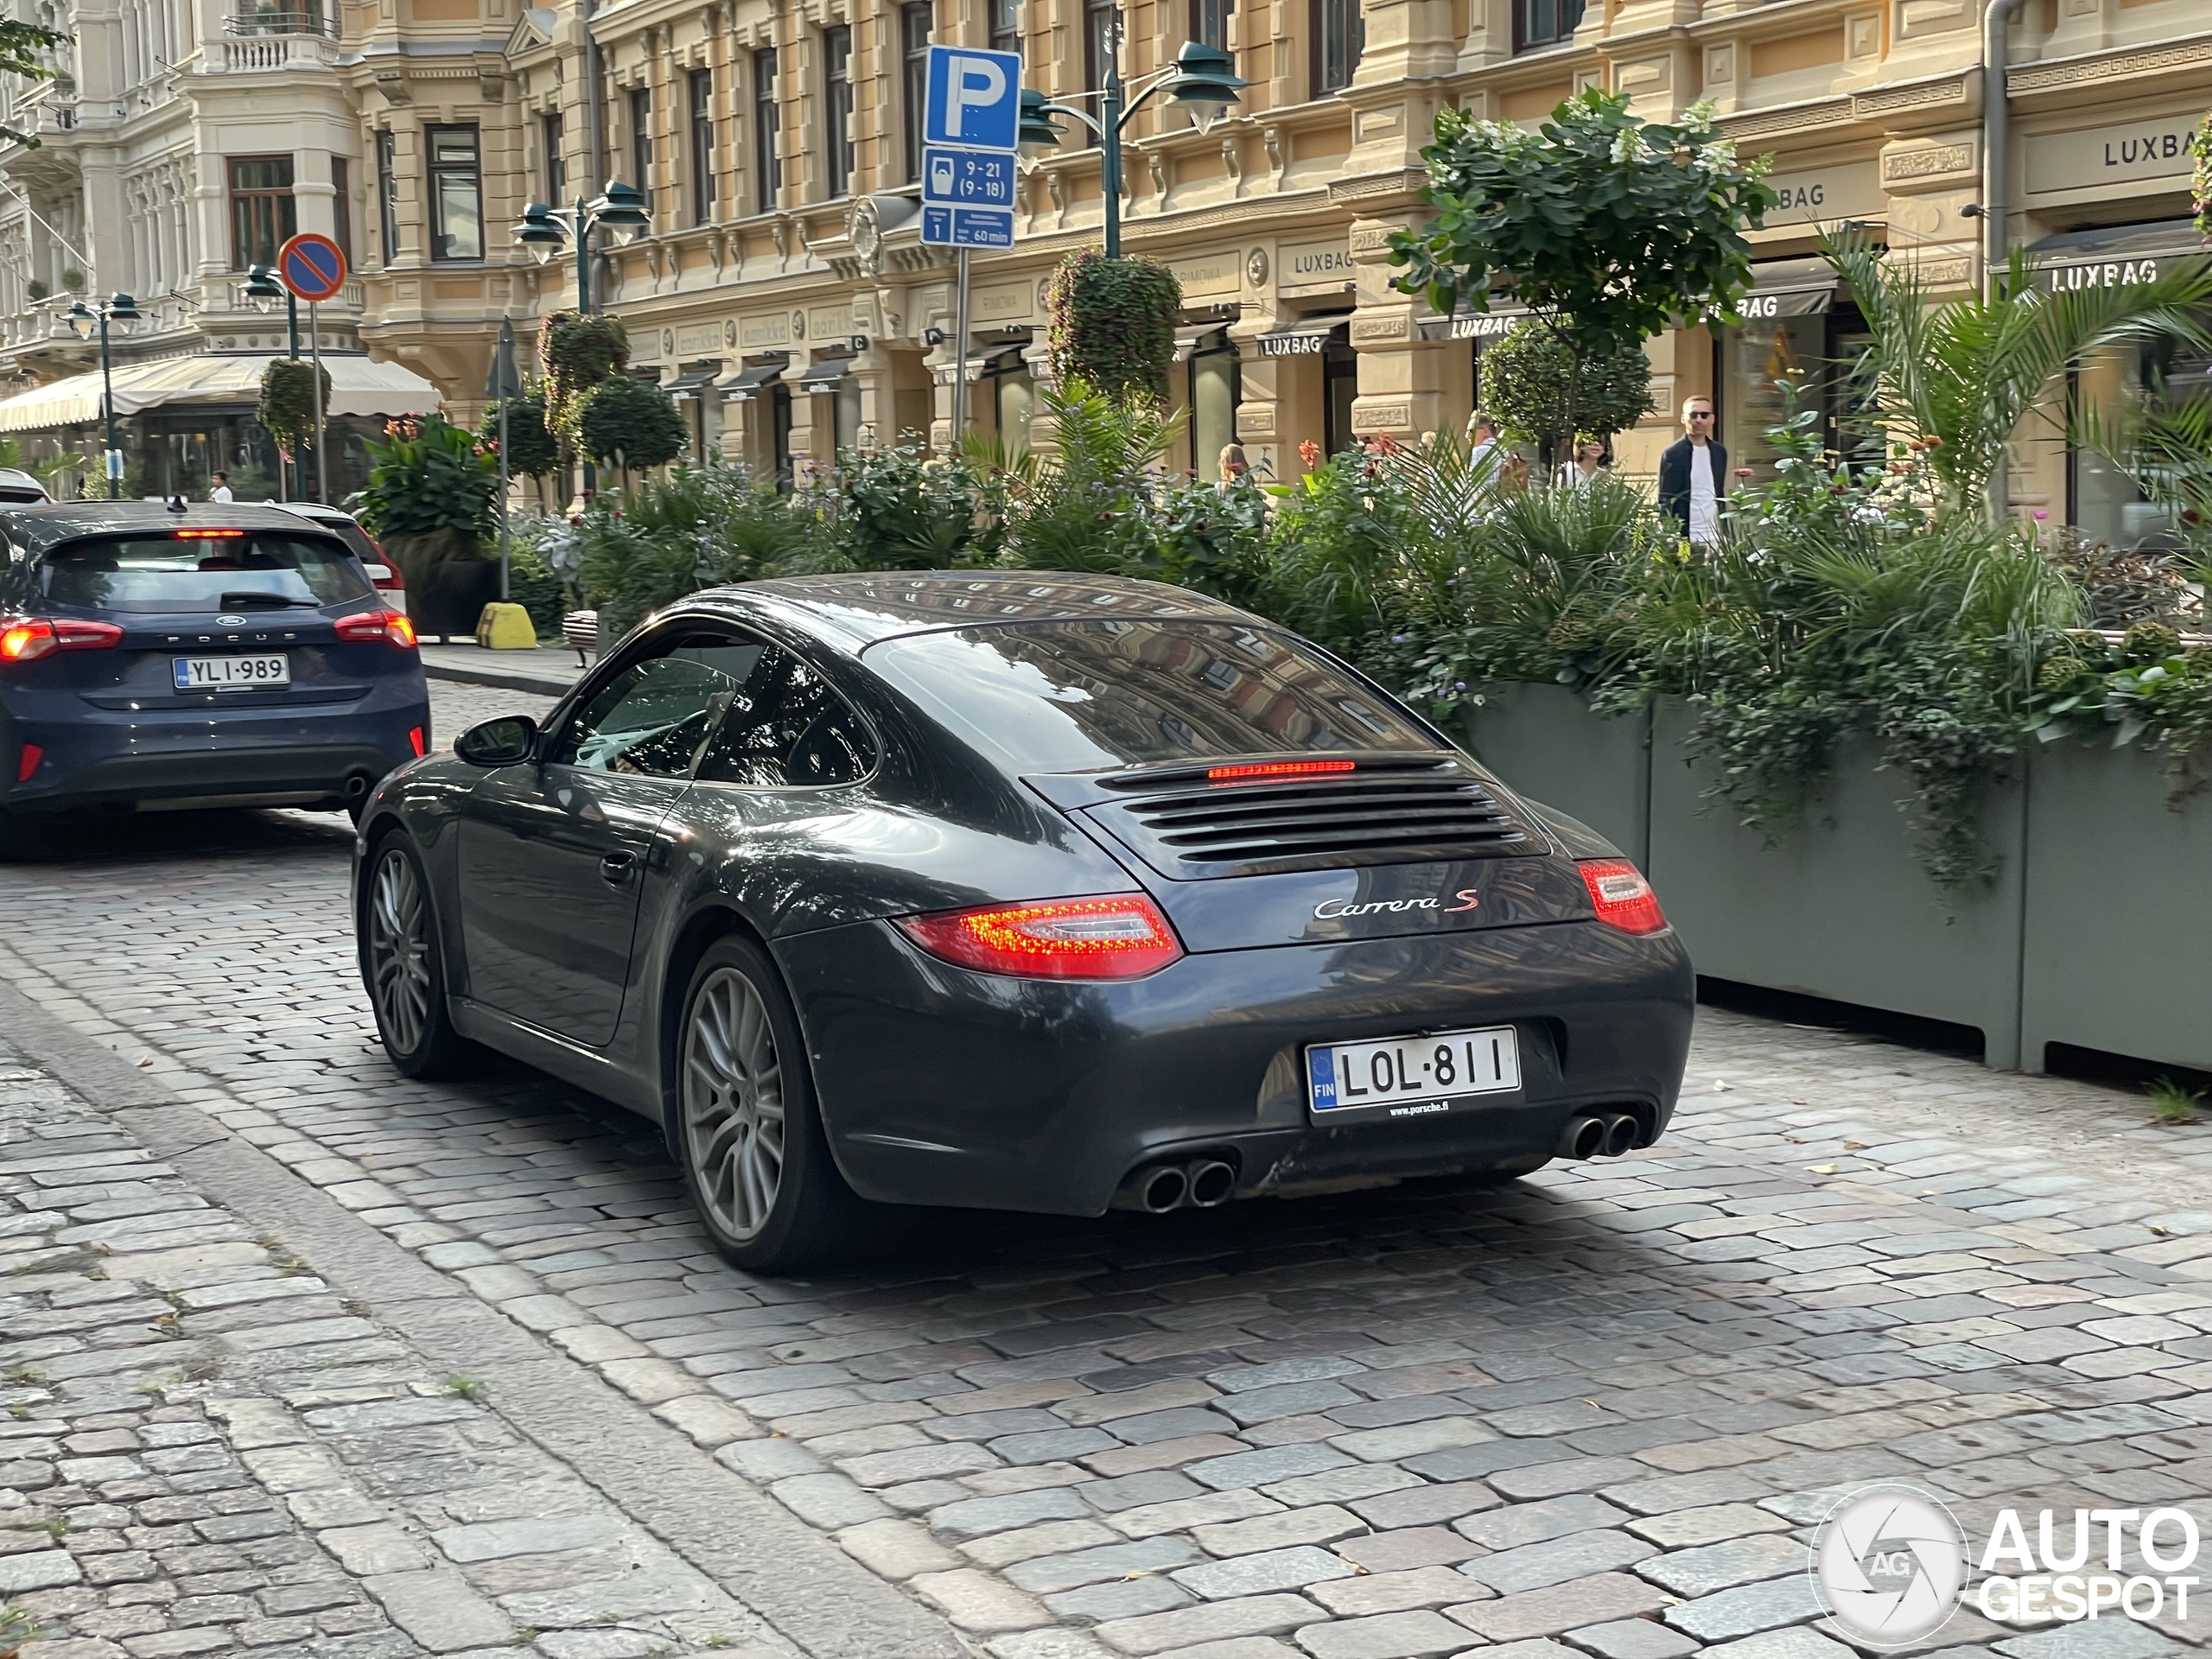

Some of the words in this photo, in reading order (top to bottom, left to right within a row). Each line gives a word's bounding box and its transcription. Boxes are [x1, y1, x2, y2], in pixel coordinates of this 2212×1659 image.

[945, 55, 1006, 137] P
[2105, 131, 2197, 166] LUXBA
[934, 224, 940, 238] 1
[974, 230, 988, 242] 60
[988, 232, 1008, 243] min
[1296, 251, 1353, 274] LUXBAG
[2051, 260, 2157, 292] LUXBAG
[1451, 316, 1516, 339] LUXBAG
[1265, 335, 1320, 356] LUXBAG
[168, 632, 296, 643] FOCUS
[192, 659, 282, 682] YLI-989
[1314, 898, 1440, 919] Carrera
[1444, 889, 1478, 912] S
[1342, 1039, 1501, 1097] LOL-811
[1314, 1083, 1335, 1098] FIN
[1389, 1101, 1449, 1117] www.porsche.fi
